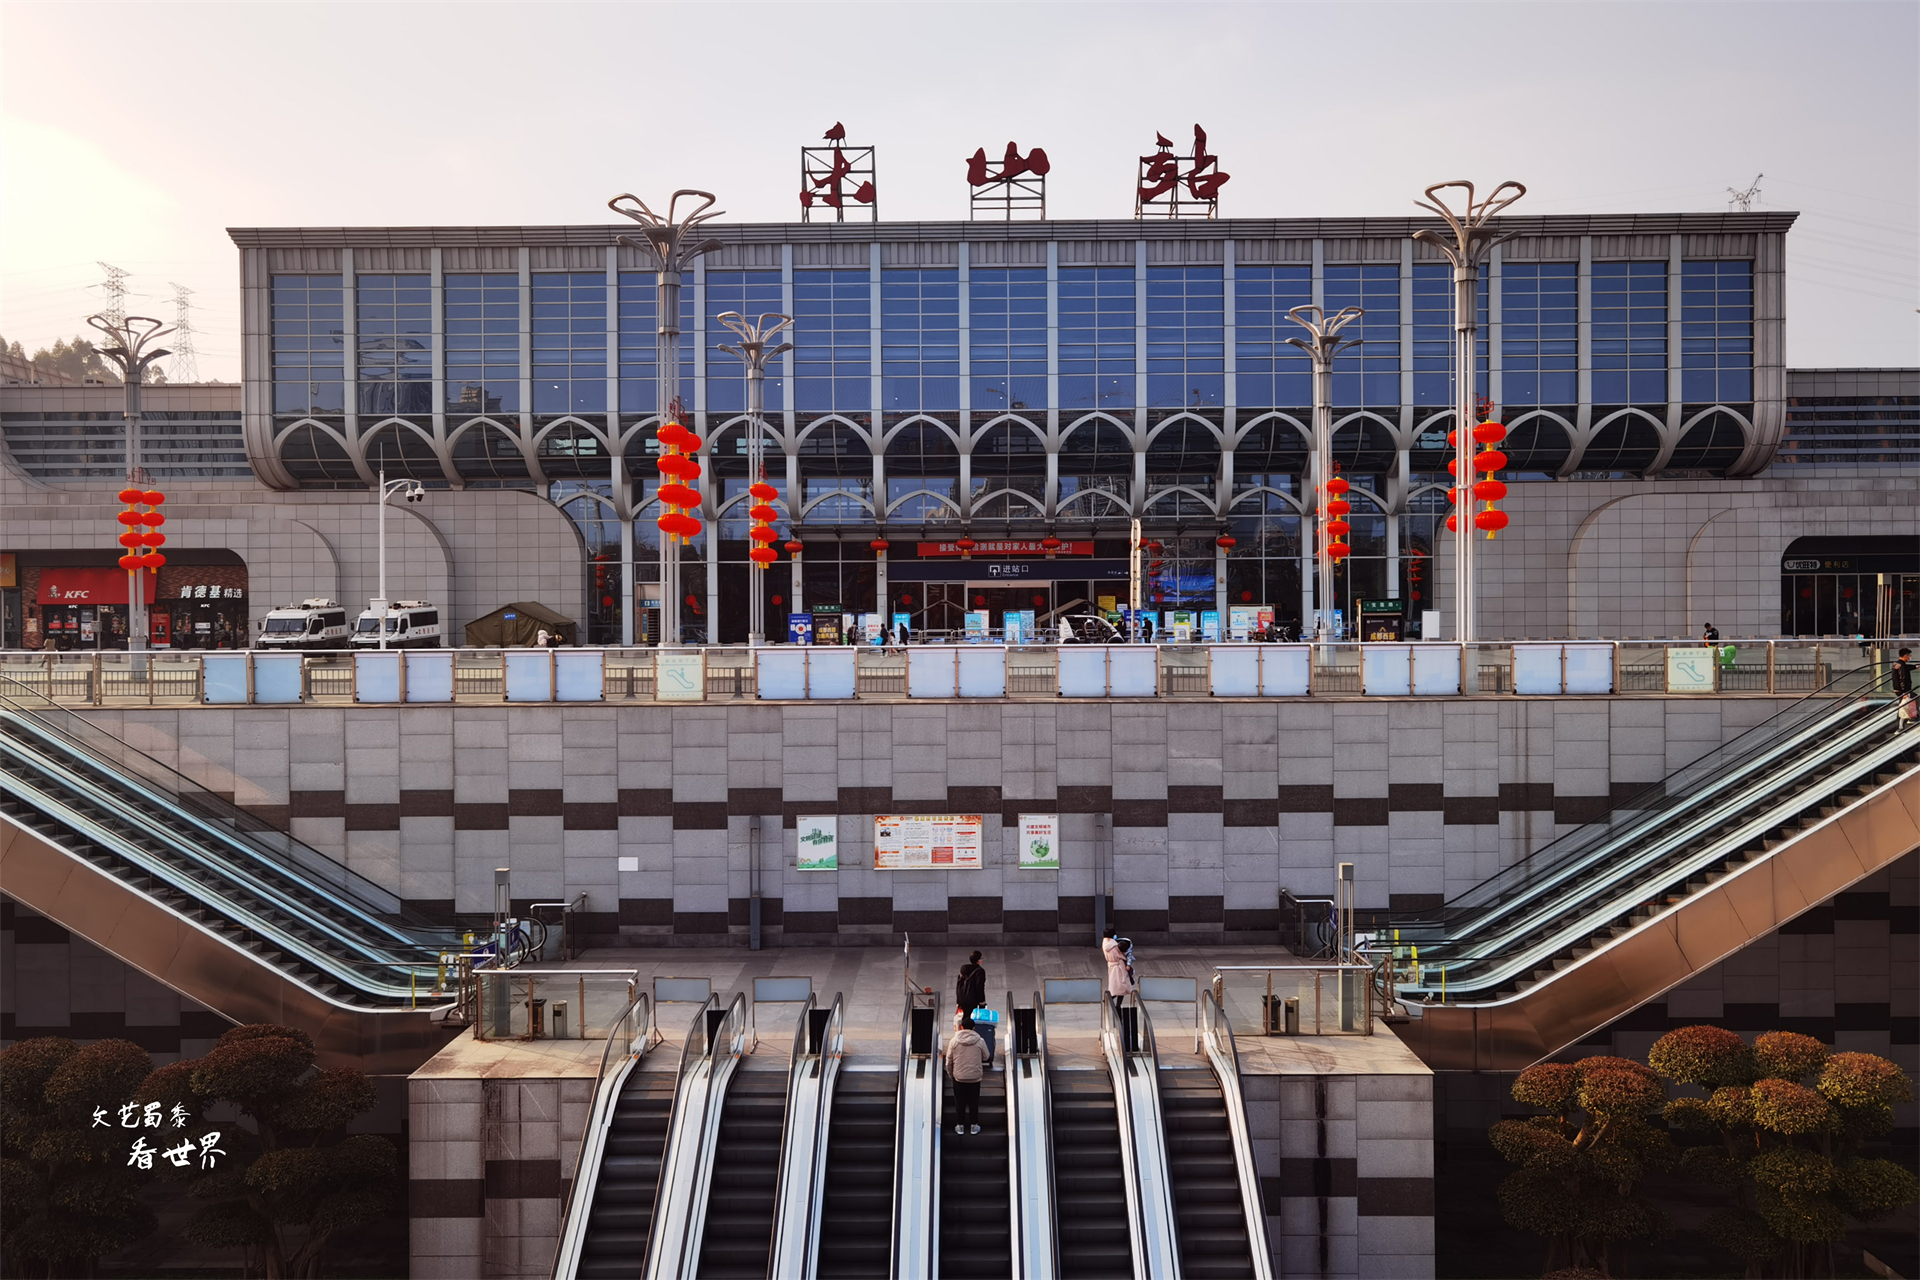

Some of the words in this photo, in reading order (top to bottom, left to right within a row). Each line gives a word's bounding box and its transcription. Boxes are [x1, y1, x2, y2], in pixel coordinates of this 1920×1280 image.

[1002, 564, 1029, 573] 进站口
[64, 590, 89, 599] KFC
[181, 585, 221, 599] 肯德基
[223, 588, 243, 598] 精选
[1370, 632, 1395, 641] 成都西部
